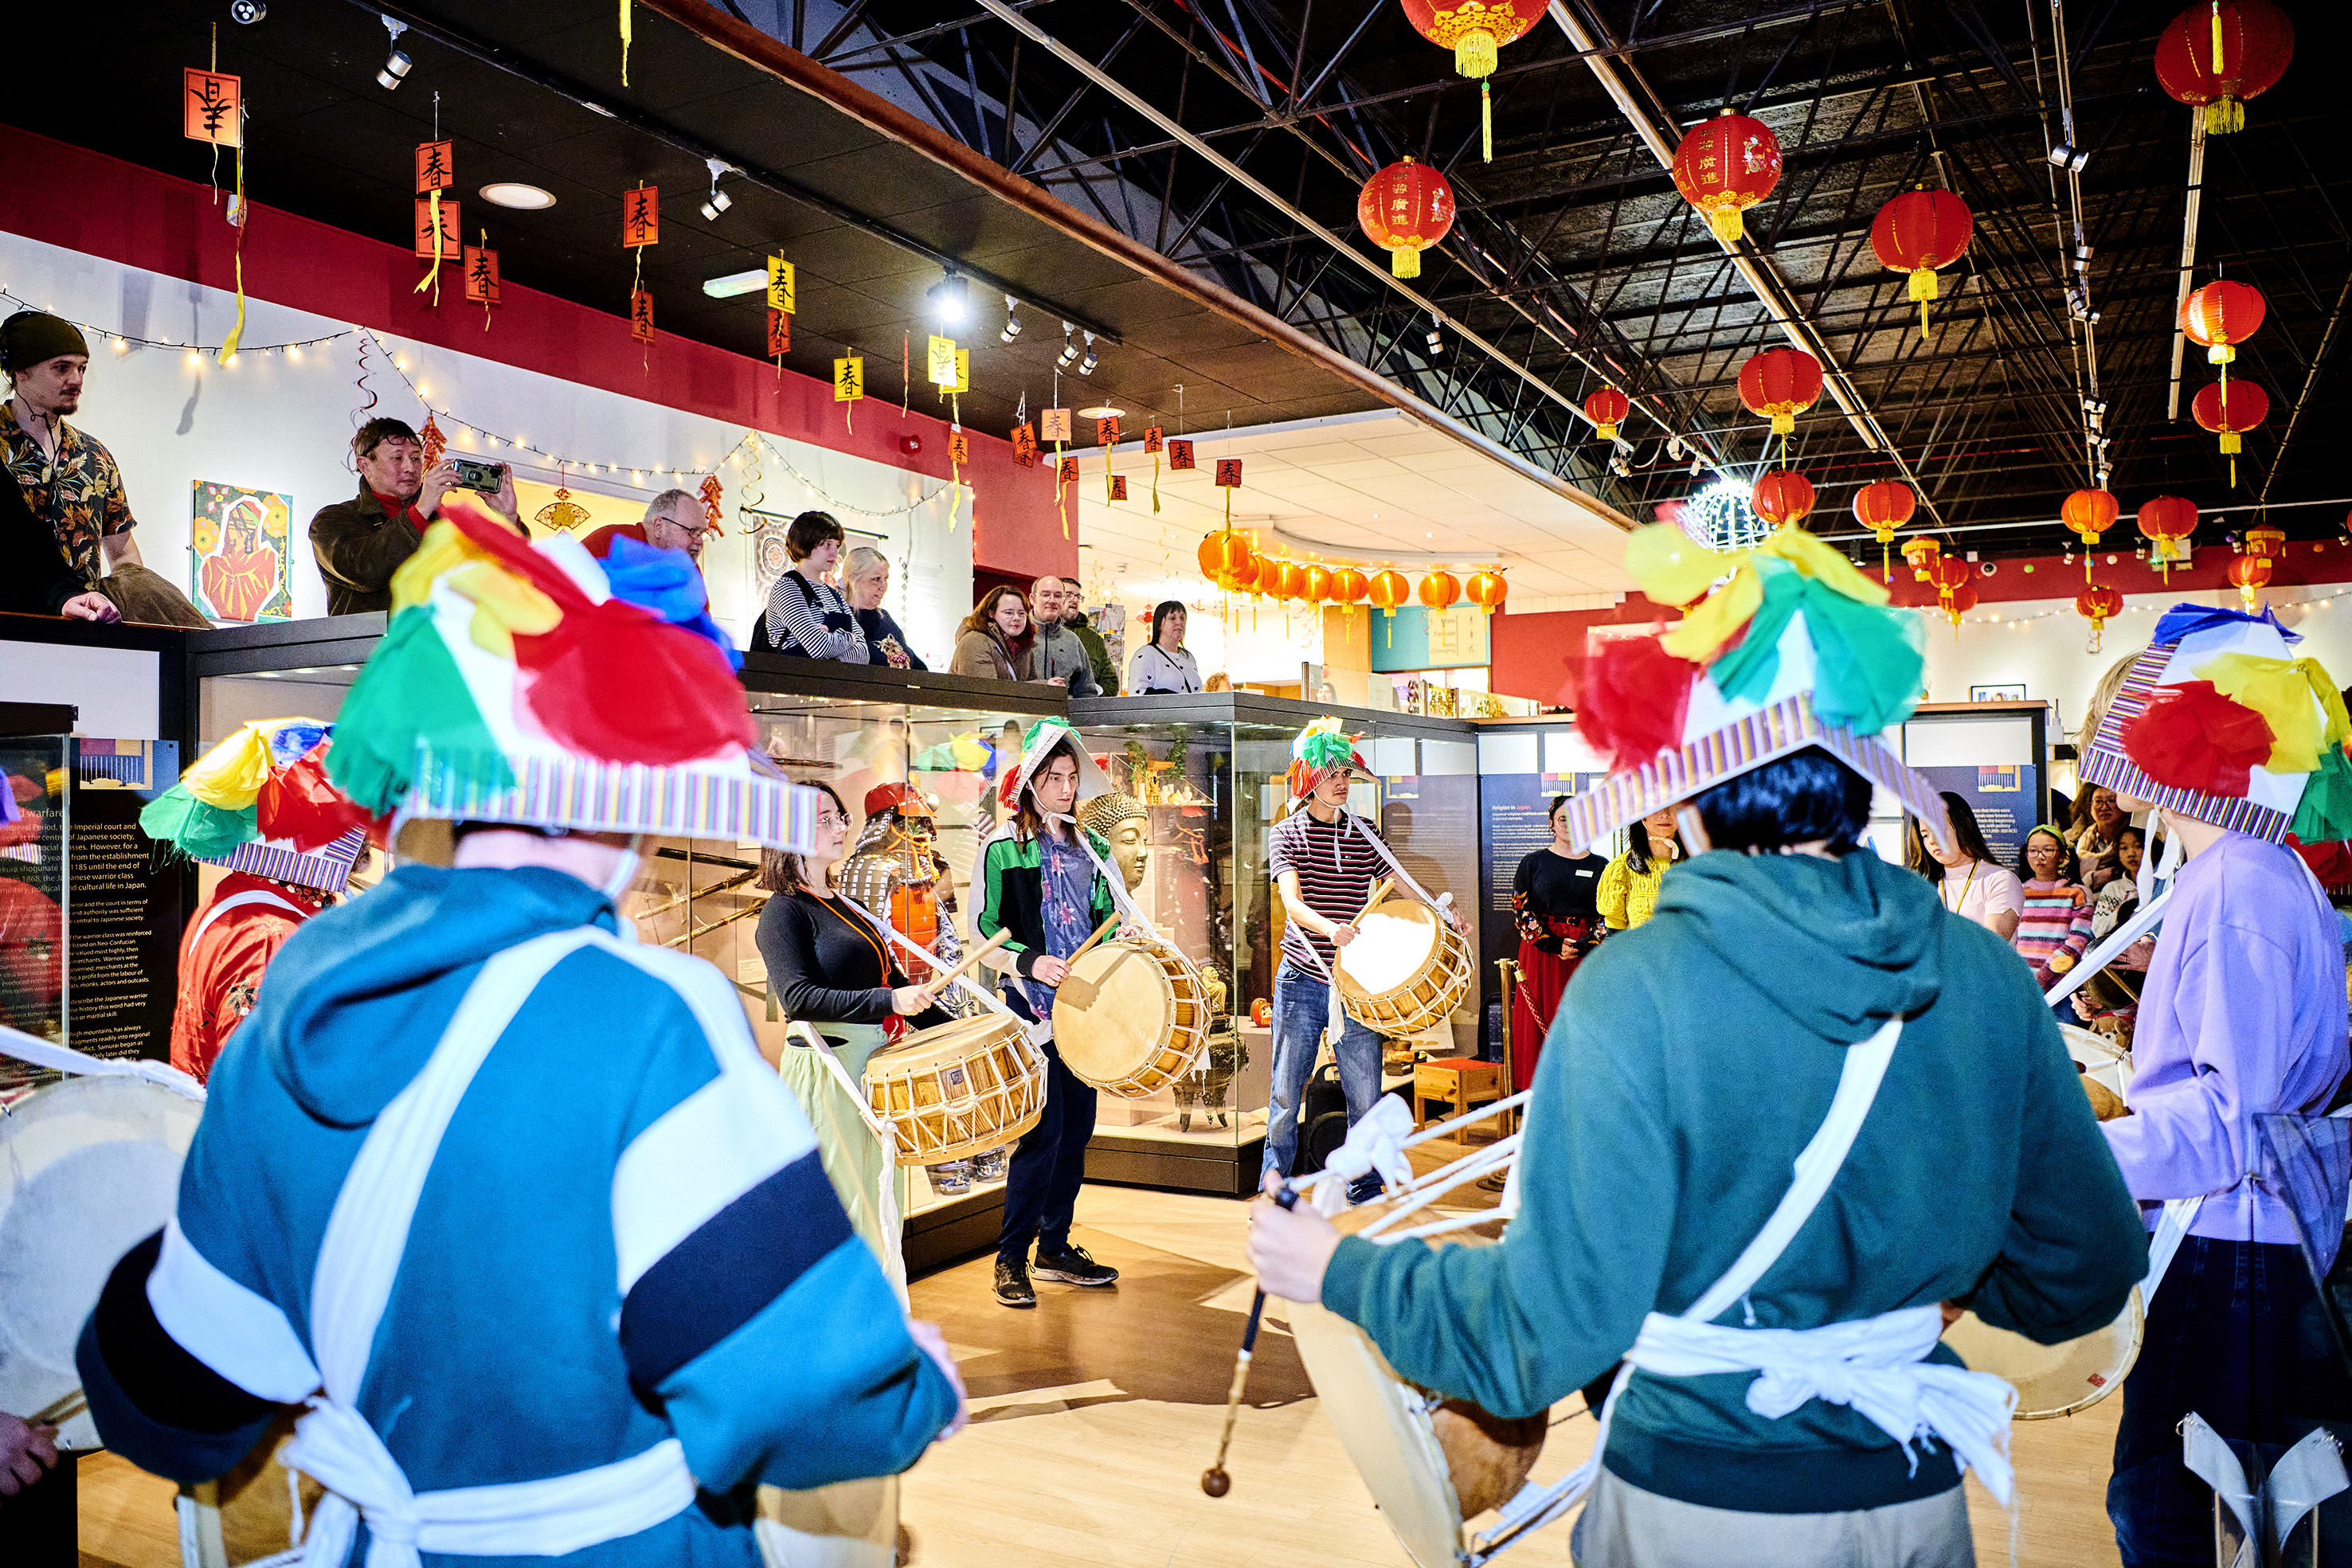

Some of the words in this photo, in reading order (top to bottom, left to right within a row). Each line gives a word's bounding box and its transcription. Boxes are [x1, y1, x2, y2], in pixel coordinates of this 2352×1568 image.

[420, 148, 451, 187] 春
[629, 193, 655, 240] 春
[468, 251, 498, 296] 春
[772, 262, 793, 305] 春
[636, 294, 653, 334] 春
[771, 309, 789, 348] 春
[839, 361, 860, 396] 春
[1046, 413, 1066, 438] 春
[1100, 418, 1118, 441] 春
[953, 436, 967, 461] 春
[1017, 428, 1035, 450] 春
[1147, 428, 1160, 452] 春
[1174, 444, 1192, 467] 春
[1060, 459, 1078, 479] 春
[1221, 461, 1241, 483] 春
